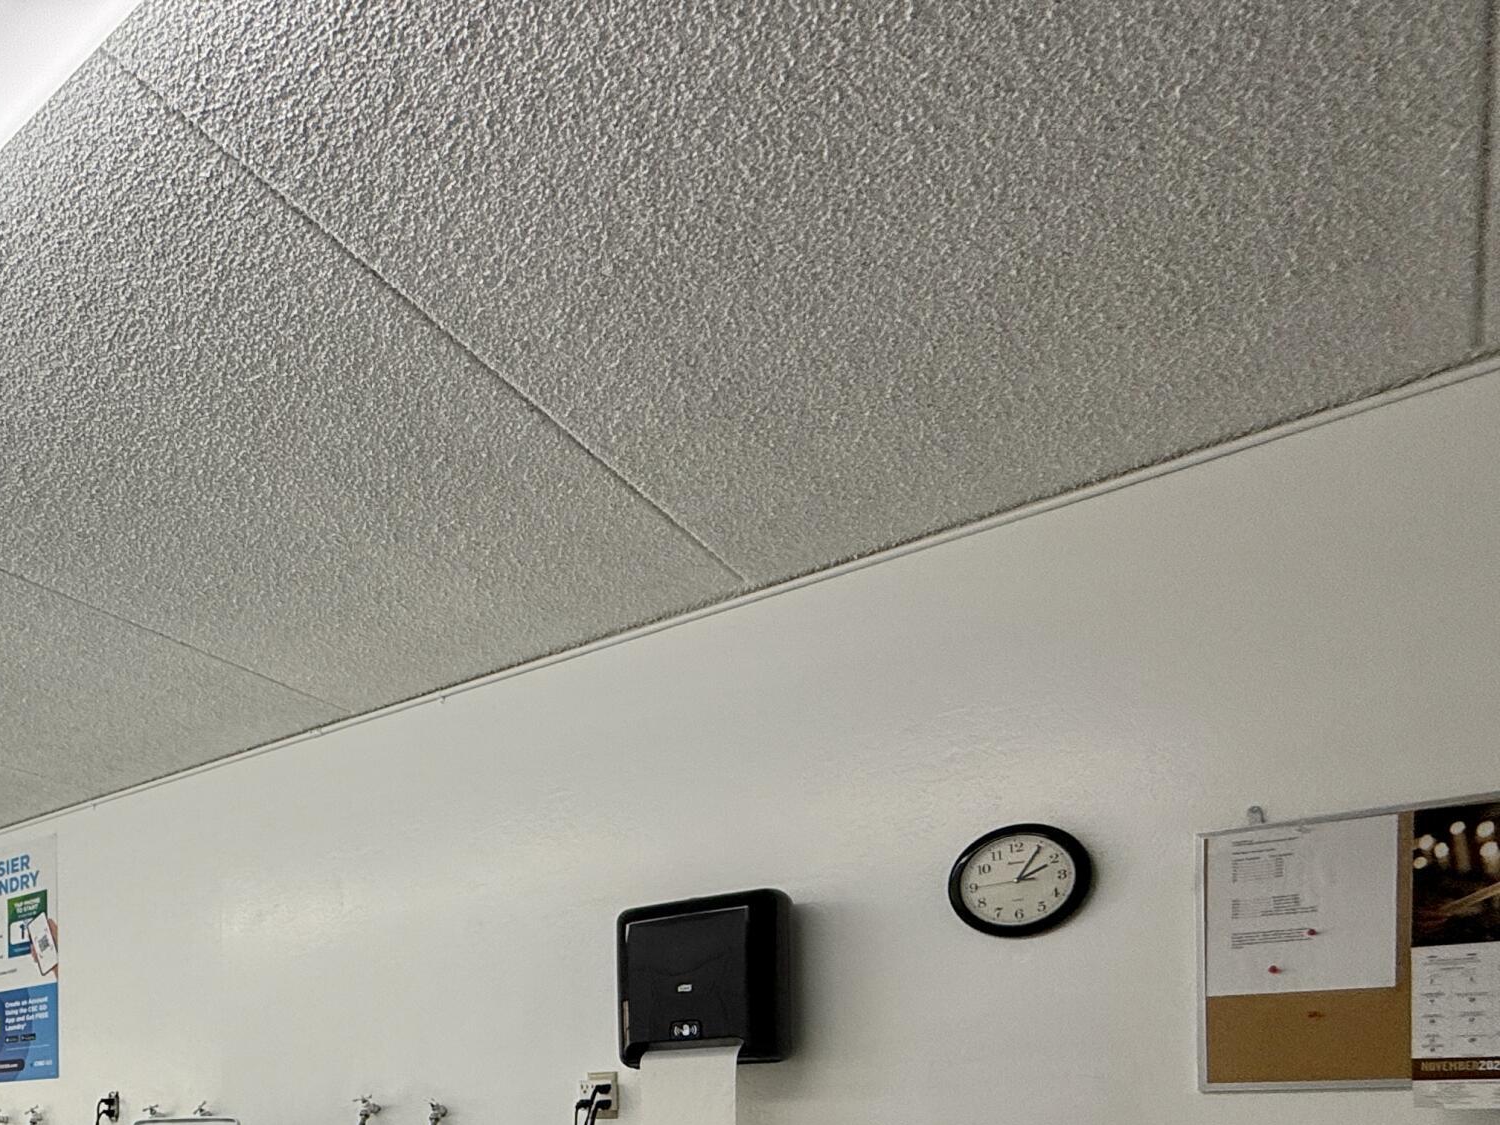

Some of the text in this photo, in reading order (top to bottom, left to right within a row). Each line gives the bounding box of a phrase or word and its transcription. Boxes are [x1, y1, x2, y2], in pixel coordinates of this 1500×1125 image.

[1009, 842, 1024, 853] 12
[991, 850, 1002, 861] 11
[1050, 853, 1060, 864] 2
[978, 863, 991, 875] 10
[1057, 869, 1067, 880] 3
[969, 883, 978, 894] 9
[978, 898, 987, 908] 8
[1037, 901, 1046, 912] 5
[994, 907, 1003, 918] 7
[1014, 908, 1024, 919] 6
